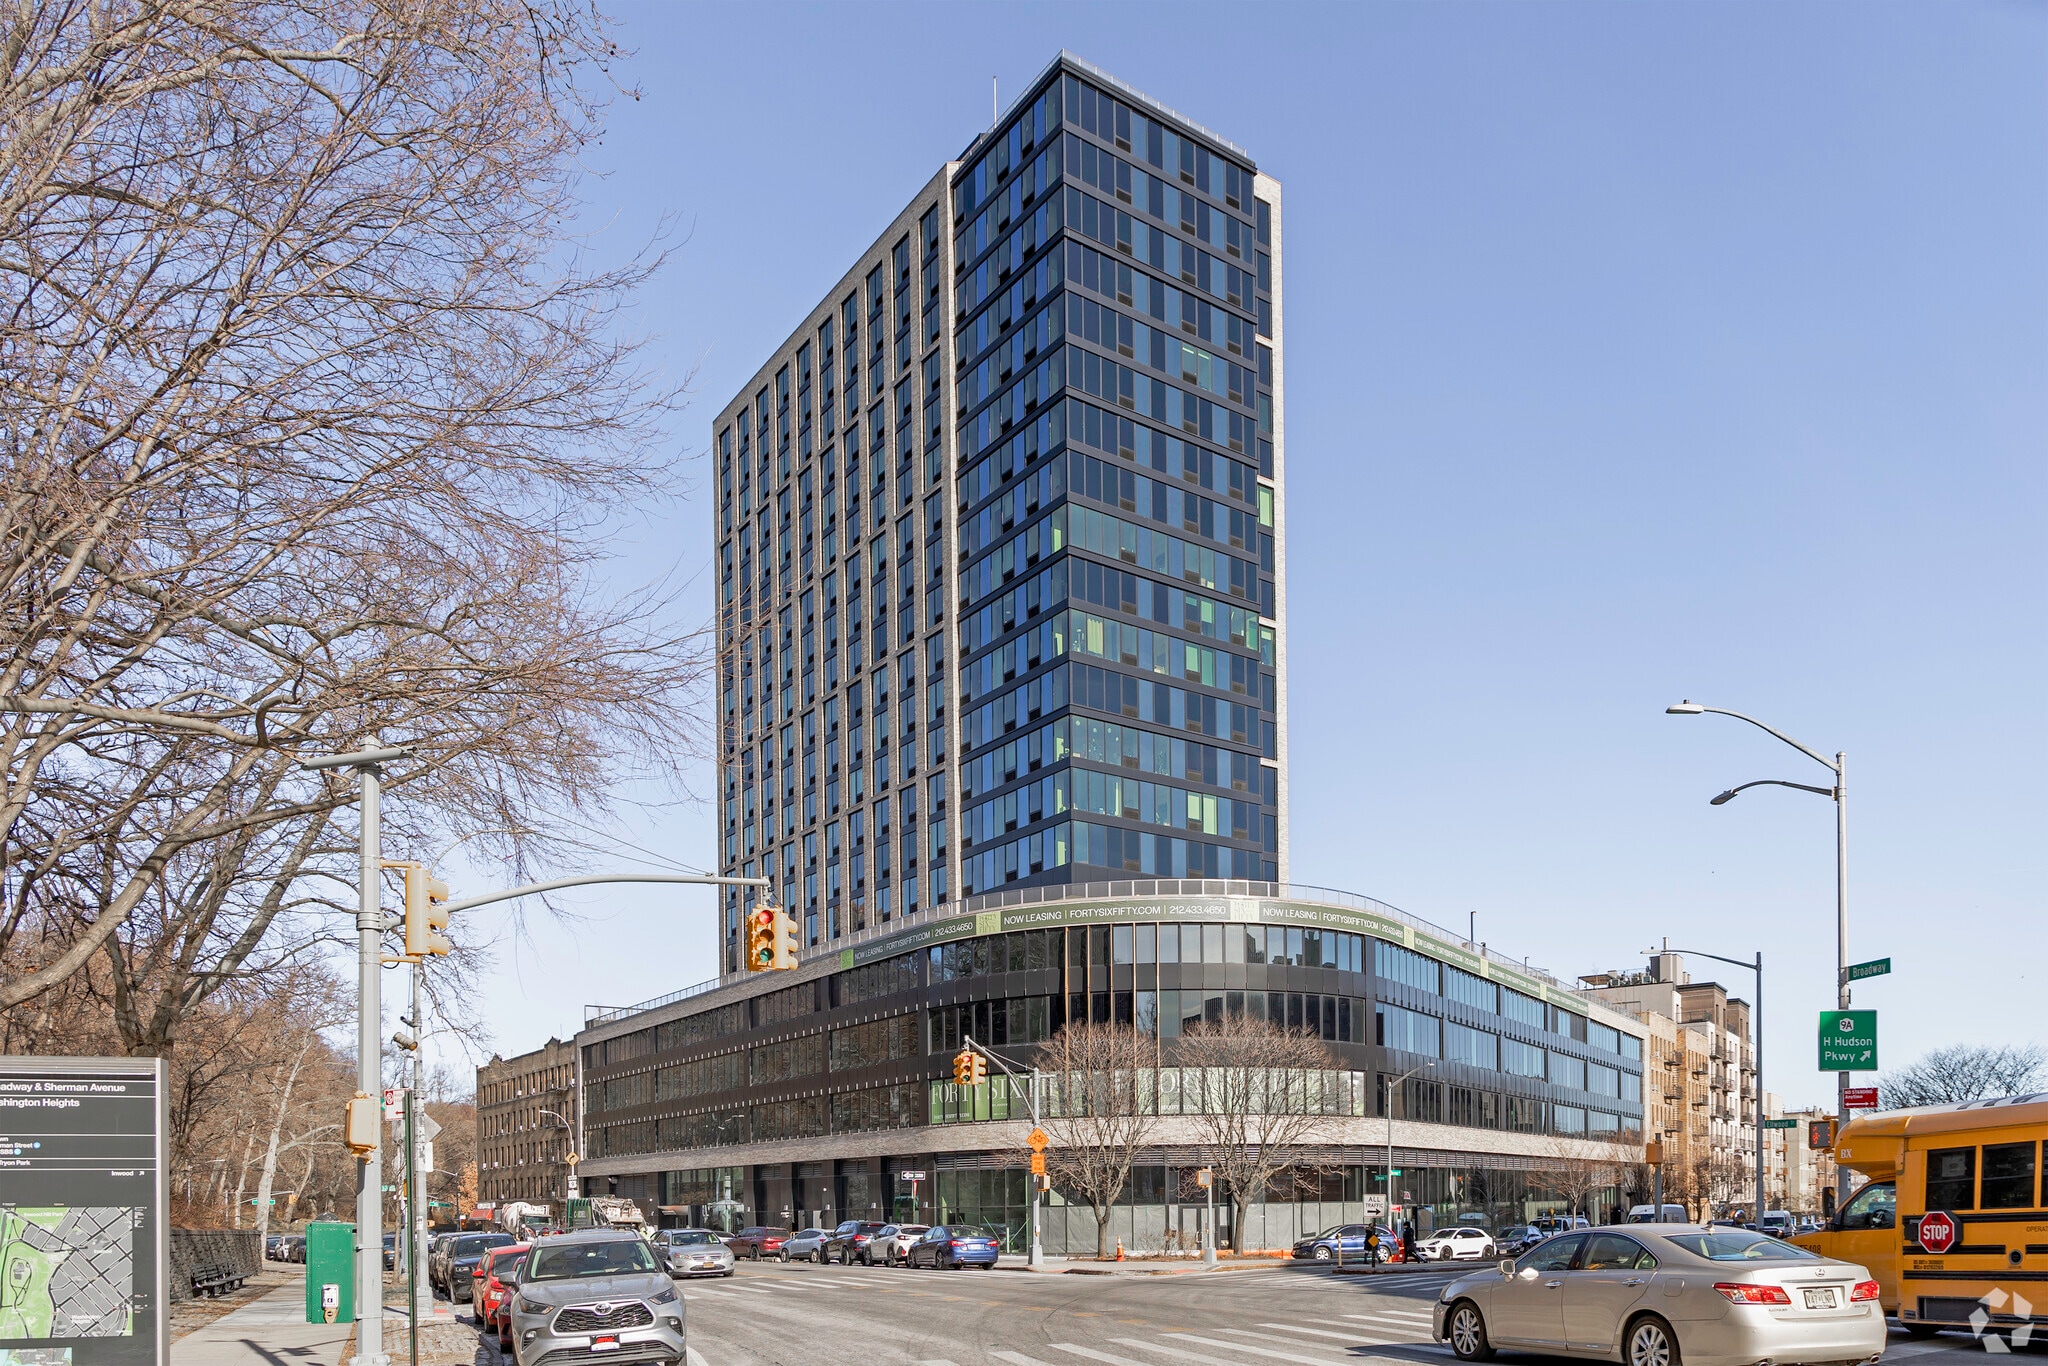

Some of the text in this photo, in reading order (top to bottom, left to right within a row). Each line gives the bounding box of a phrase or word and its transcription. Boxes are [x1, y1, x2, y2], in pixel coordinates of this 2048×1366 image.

[1004, 905, 1226, 925] NOW LEASING FORTYSIXFIFTY.COM 212.433.4650
[1263, 907, 1284, 917] NOW
[1285, 909, 1317, 921] LEASING
[855, 951, 865, 961] NOW
[865, 945, 883, 957] LEASING
[934, 922, 974, 937] 212.433.4650
[1852, 963, 1886, 978] Broadway
[1841, 1021, 1853, 1030] 9A
[1823, 1036, 1873, 1046] H Hudson
[1825, 1051, 1856, 1062] Pkwy
[44, 1082, 88, 1092] Sherman
[89, 1083, 126, 1092] Avenue
[42, 1098, 81, 1109] Heights
[1766, 1120, 1789, 1128] Ellwood
[1840, 1148, 1852, 1159] BX
[1923, 1224, 1950, 1241] STOP
